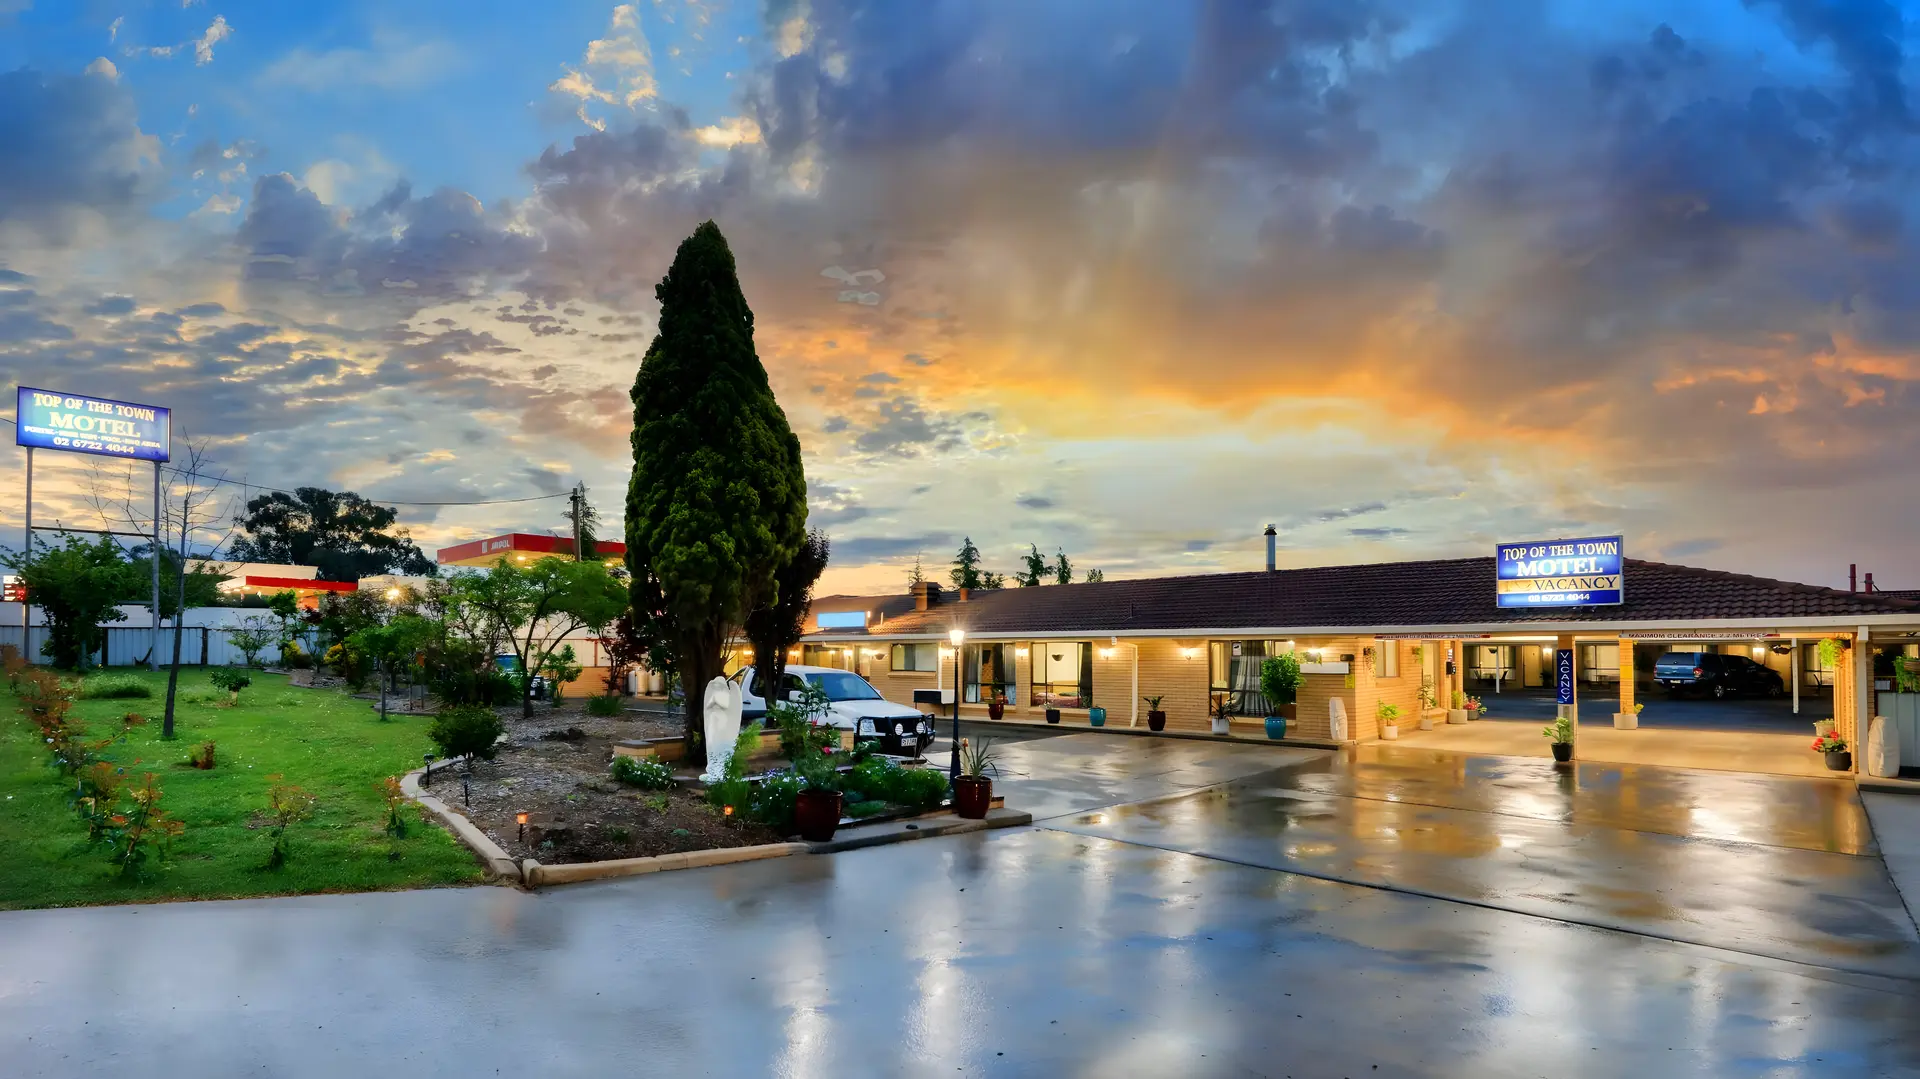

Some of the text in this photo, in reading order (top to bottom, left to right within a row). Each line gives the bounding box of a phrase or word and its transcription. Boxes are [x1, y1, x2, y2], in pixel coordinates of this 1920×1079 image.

[34, 392, 155, 422] TOP OF THE TOWN
[48, 411, 141, 438] MOTEL
[53, 436, 70, 446] 02
[72, 440, 103, 451] 6722
[106, 443, 135, 454] 4044
[1503, 541, 1618, 561] TOP OF THE TOWN
[1516, 557, 1603, 577] MOTEL
[1533, 576, 1617, 591] VACANCY
[1560, 652, 1570, 701] VACANCY
